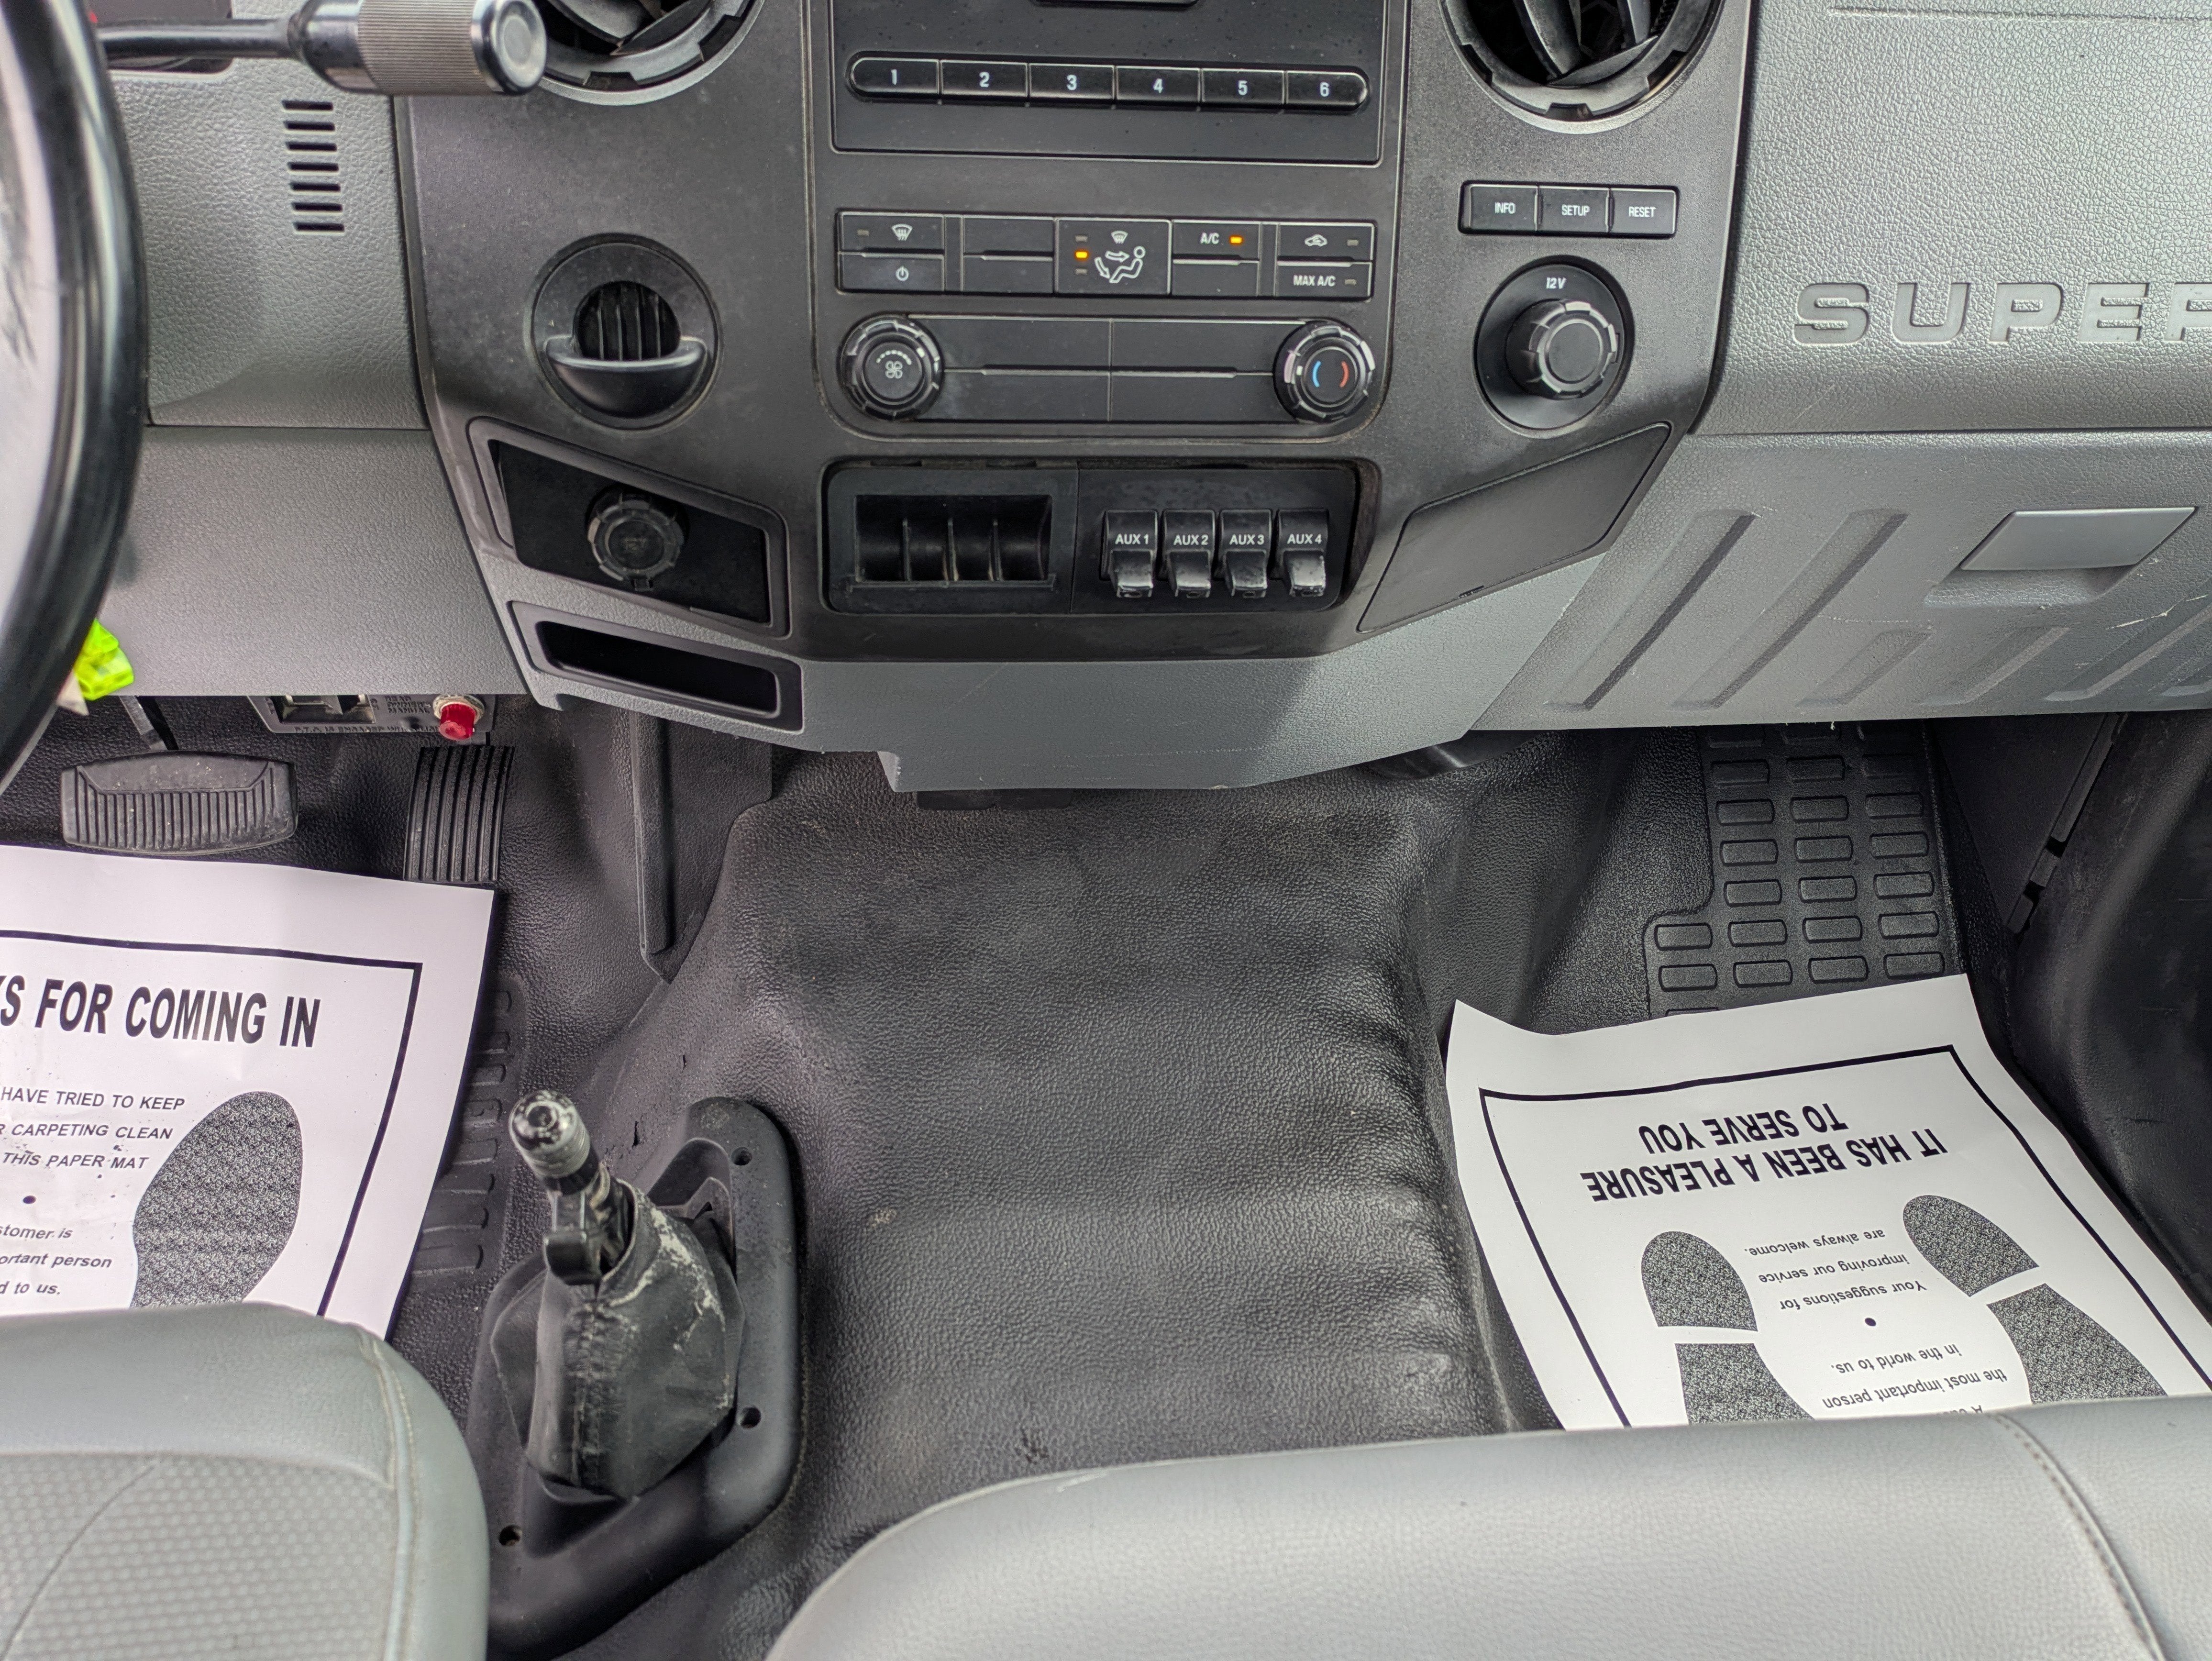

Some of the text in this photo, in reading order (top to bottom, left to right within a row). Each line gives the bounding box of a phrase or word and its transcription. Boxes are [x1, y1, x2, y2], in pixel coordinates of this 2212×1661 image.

[891, 69, 897, 85] 1
[979, 71, 990, 88] 2
[1067, 74, 1077, 91] 3
[1153, 78, 1163, 94] 4
[1238, 80, 1248, 96] 5
[1320, 81, 1330, 97] 6
[1494, 202, 1516, 214] INFO
[1561, 204, 1590, 216] SETUP
[1628, 206, 1657, 217] RESET
[1200, 232, 1219, 244] A/C
[1293, 275, 1336, 287] MAX A/C
[1546, 277, 1566, 289] 12V
[1115, 533, 1149, 545] AUX 1
[1173, 534, 1208, 545] AUX 2
[1229, 534, 1264, 545] AUX 3
[1287, 533, 1322, 544] AUX 4
[34, 978, 113, 1034] FOR
[125, 986, 267, 1044] COMING
[279, 996, 321, 1048] IN
[1, 1086, 185, 1110] HAVE TRIED TO KEEP
[11, 1124, 109, 1136] CARPETING
[115, 1126, 173, 1139] CLEAN
[1638, 1103, 1849, 1154] TO SERVE YOU
[3, 1152, 150, 1169] THIS PAPER MAT
[1580, 1128, 1948, 1202] IT HAS BEEN A PLEASURE
[58, 1228, 73, 1239] is
[1744, 1229, 1885, 1256] are always welcome.
[51, 1256, 112, 1268] person
[1758, 1254, 1910, 1283] improving our service
[14, 1282, 30, 1294] to
[36, 1284, 61, 1295] us.
[1780, 1280, 1927, 1310] Your suggestions for
[1830, 1344, 1962, 1373] in the world to us.
[1822, 1369, 2008, 1408] the most important person
